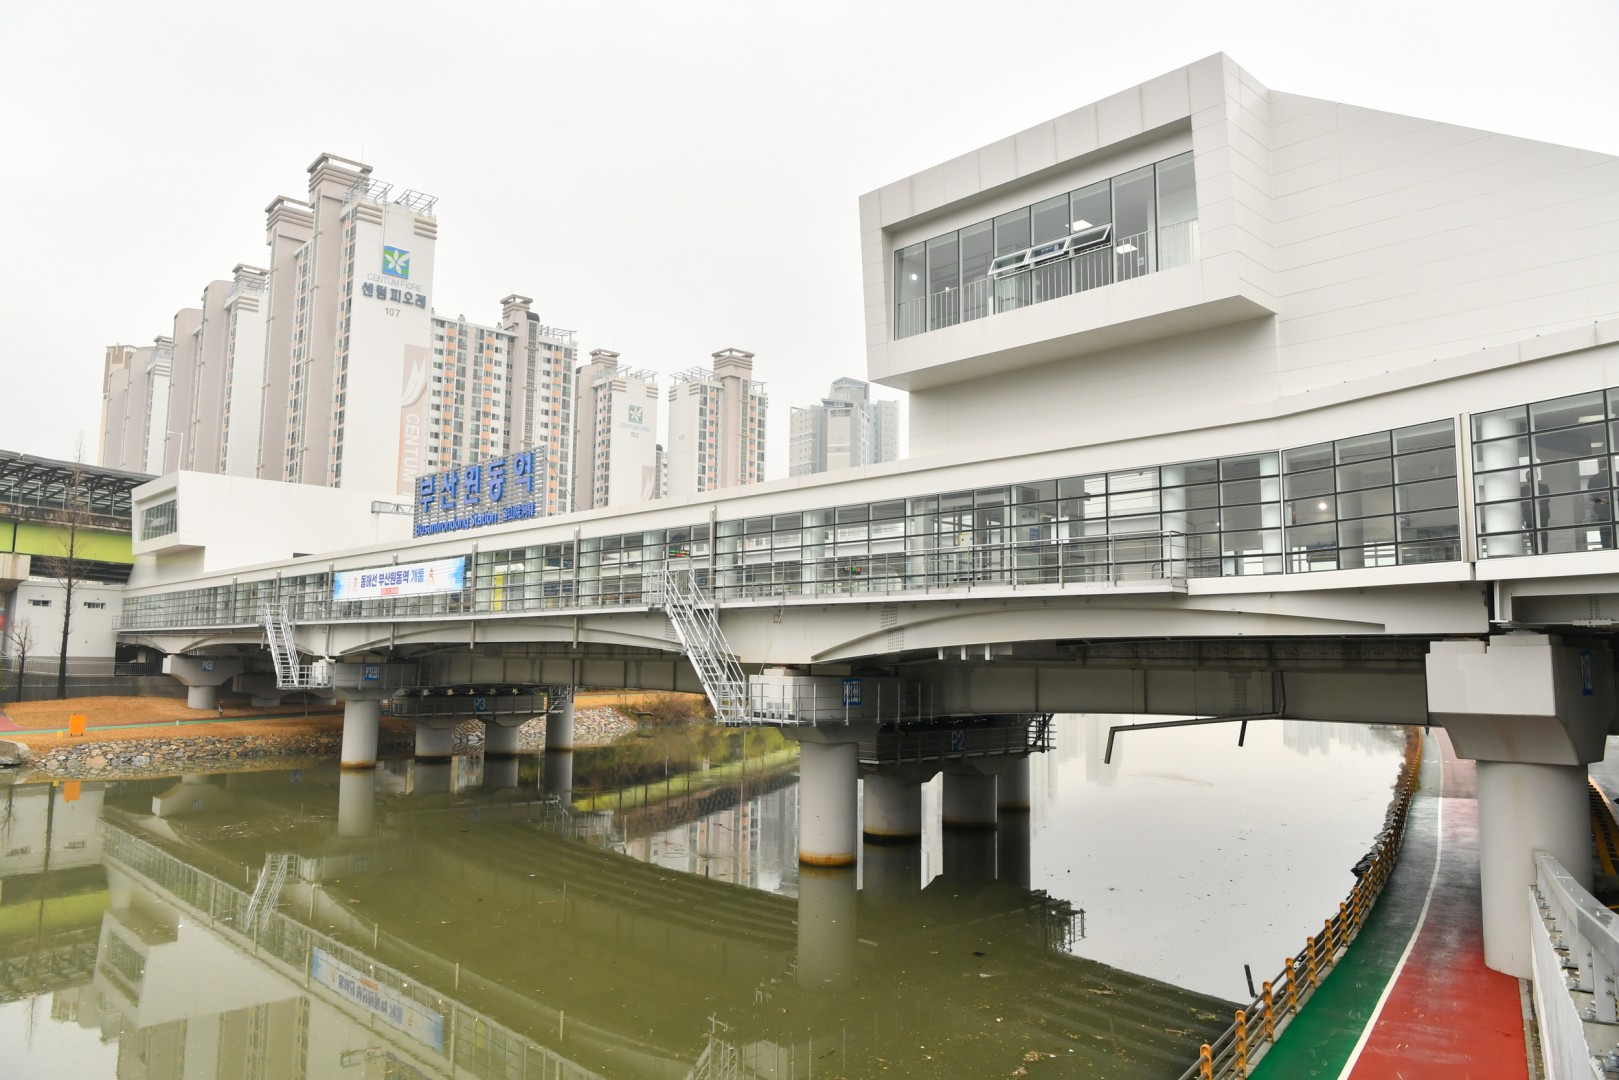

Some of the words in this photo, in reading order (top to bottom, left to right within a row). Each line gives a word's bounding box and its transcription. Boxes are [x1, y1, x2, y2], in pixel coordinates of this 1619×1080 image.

[367, 272, 400, 288] CENTUM
[400, 280, 423, 292] FIORE
[384, 307, 400, 318] 107
[402, 413, 420, 482] CENTUM
[419, 451, 534, 513] 부산원동역
[415, 515, 470, 537] Busanwondong
[471, 510, 498, 527] Station
[361, 574, 377, 588] 동해선
[379, 569, 409, 587] 부산원동역
[411, 568, 424, 583] 개통
[474, 697, 486, 710] P3
[951, 730, 966, 752] P2
